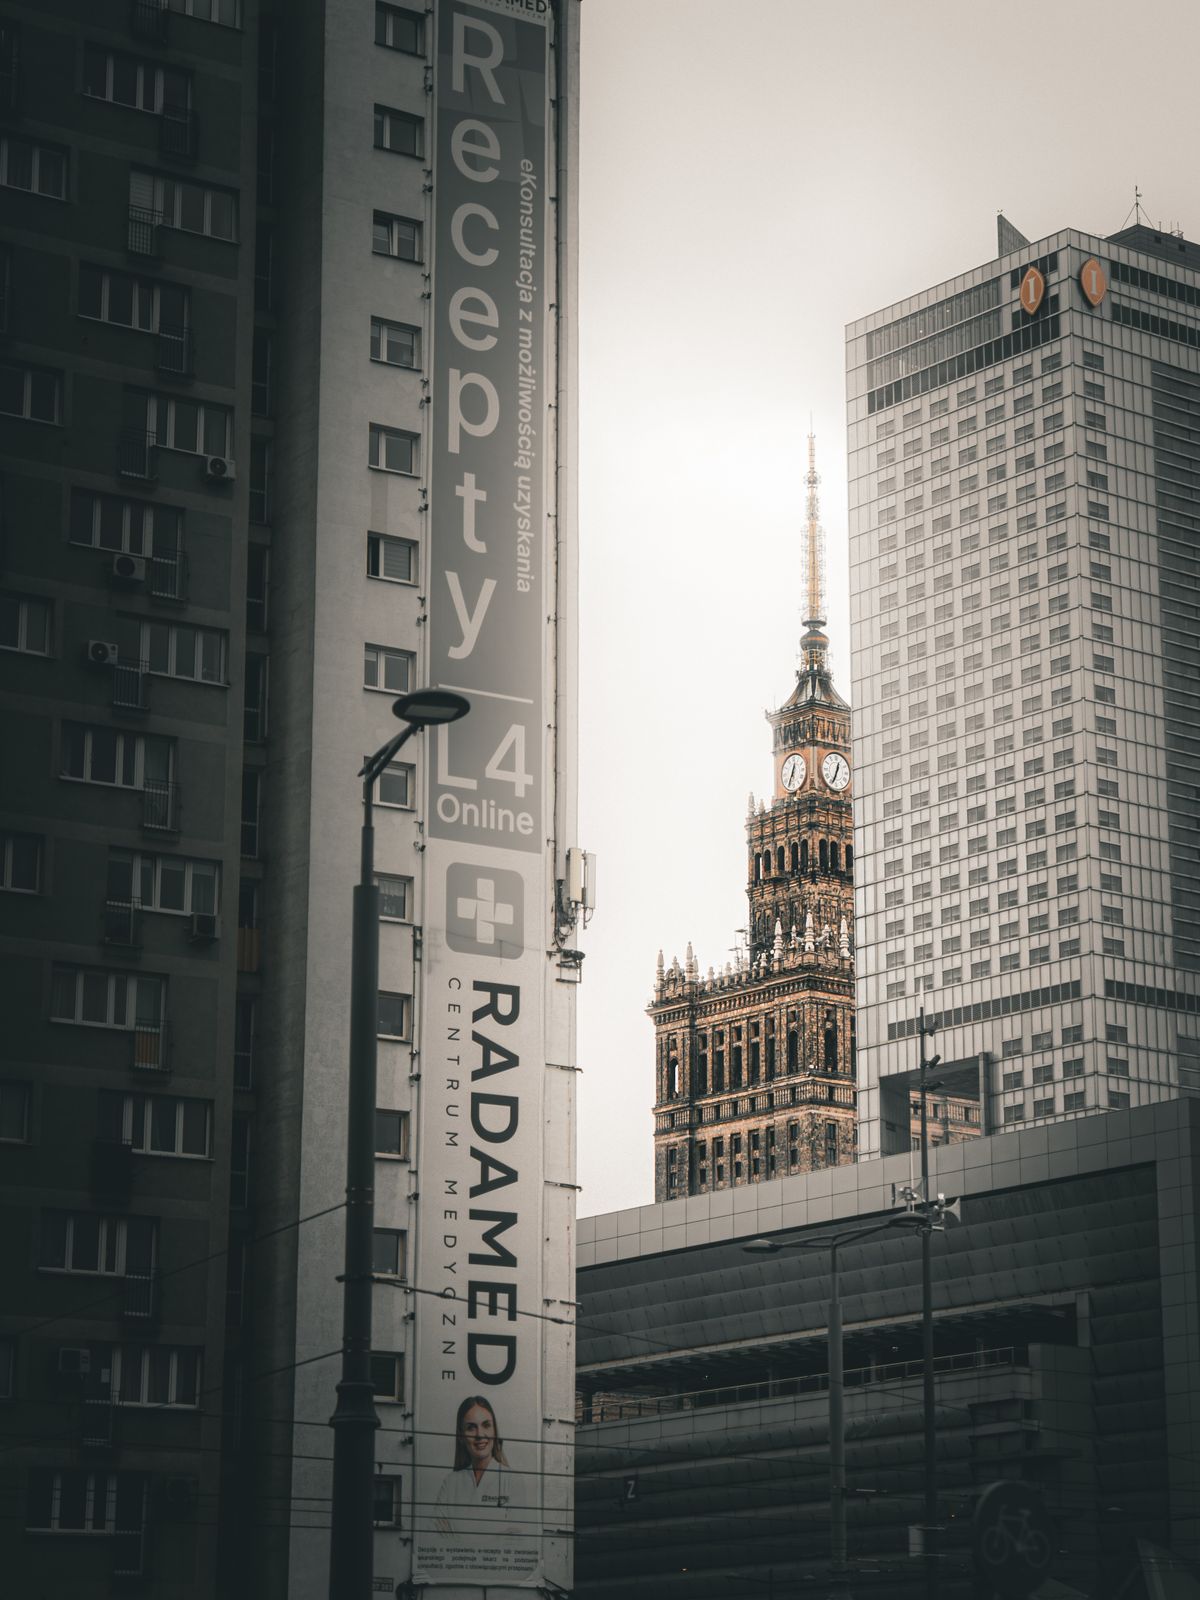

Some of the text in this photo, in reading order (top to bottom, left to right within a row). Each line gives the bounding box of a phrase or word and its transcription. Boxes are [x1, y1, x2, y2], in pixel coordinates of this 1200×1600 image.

[444, 11, 506, 661] Recepty
[512, 158, 538, 593] eKonsultacja z możliwością uzyskania
[436, 793, 535, 836] Online
[437, 723, 534, 798] L4
[440, 978, 462, 1382] CENTRUM MEDYCZNE
[467, 980, 520, 1386] RADAMED
